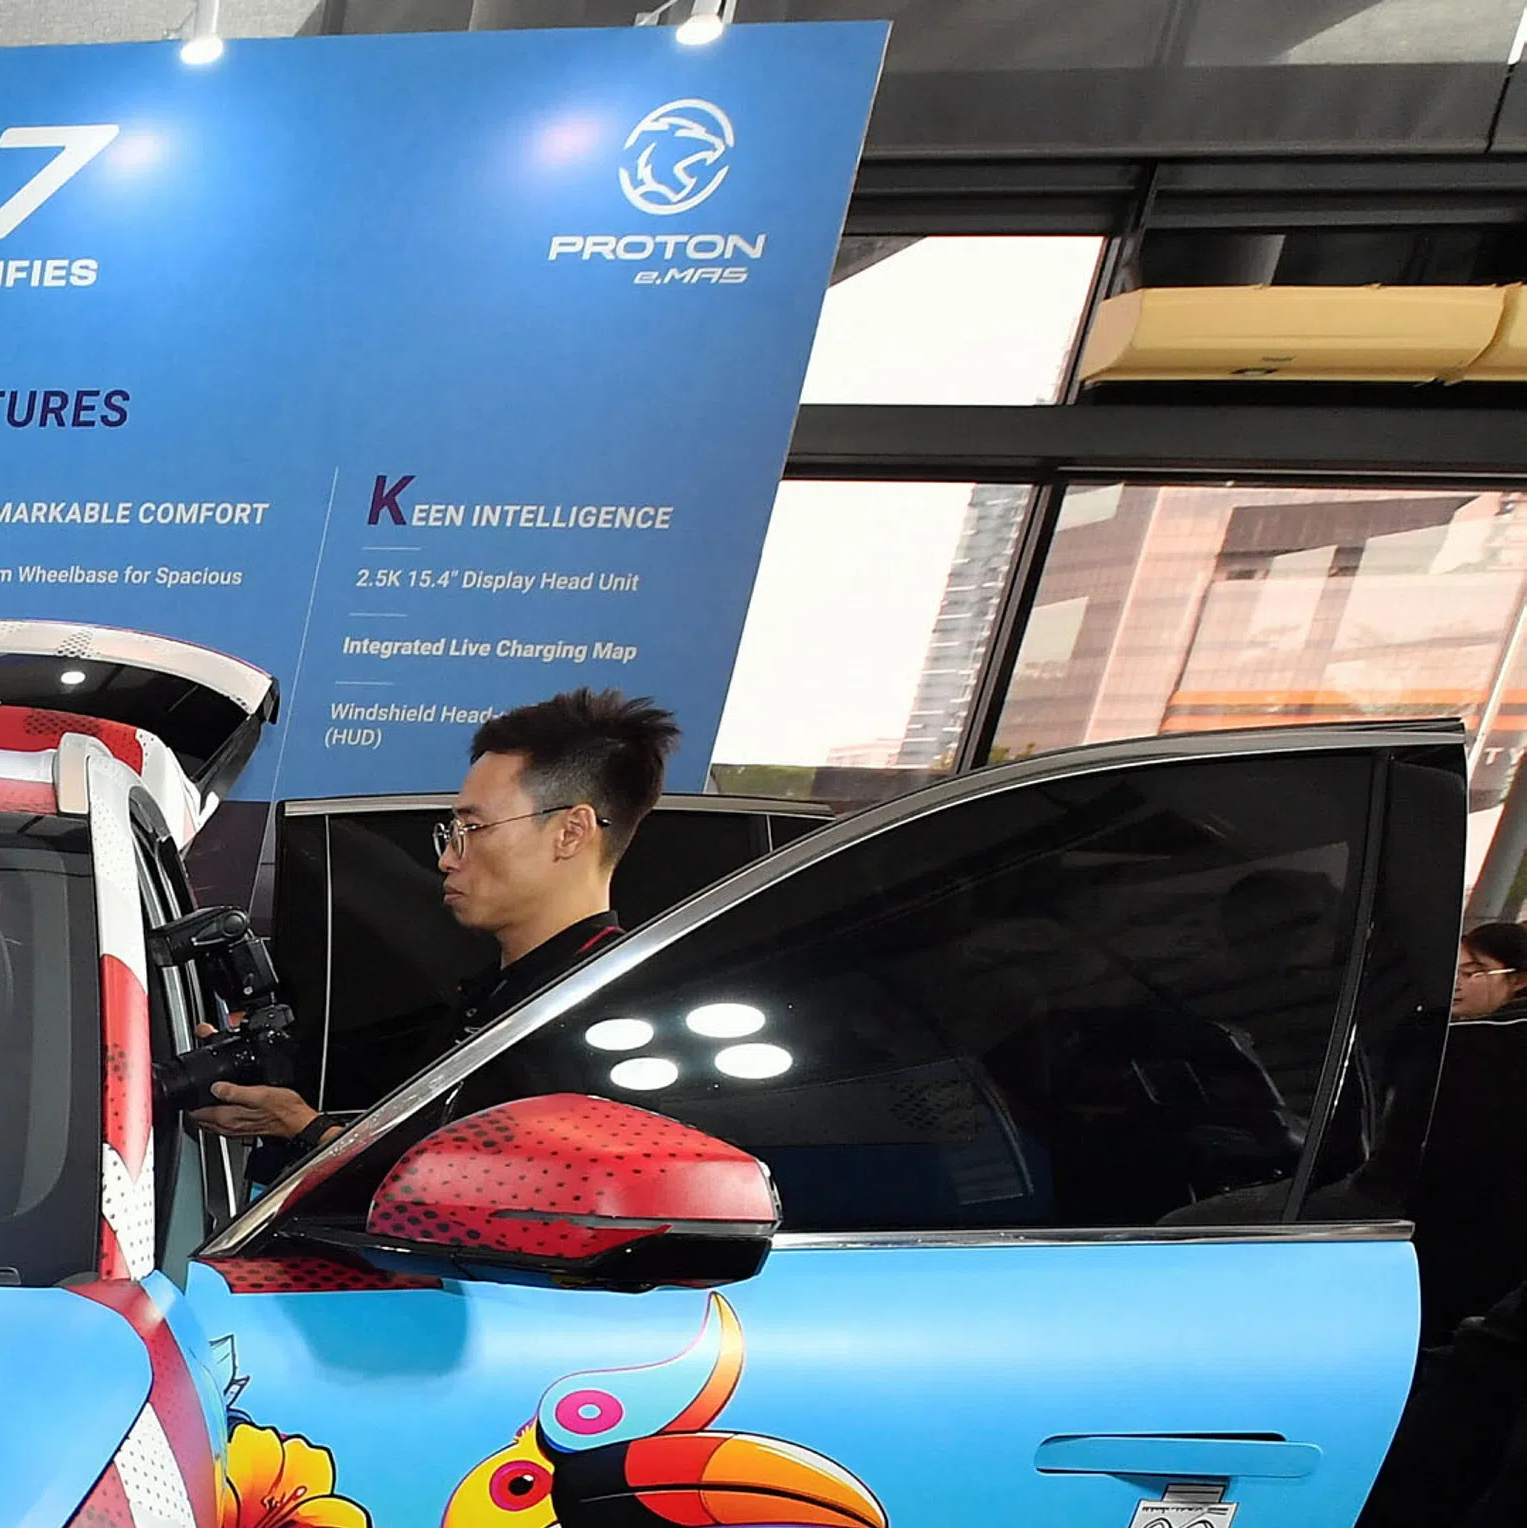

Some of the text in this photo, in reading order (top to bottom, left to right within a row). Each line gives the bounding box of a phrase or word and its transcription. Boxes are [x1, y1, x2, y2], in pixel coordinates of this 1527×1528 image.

[548, 233, 767, 260] PROTON
[138, 502, 269, 525] COMFORT
[367, 475, 674, 529] KEEN INTELLIGENCE
[18, 566, 119, 583] Wheelbase
[123, 566, 151, 584] for
[155, 567, 243, 588] Spacious
[356, 569, 402, 587] 2.5K
[461, 570, 535, 593] Display
[540, 572, 592, 590] Head
[598, 573, 639, 592] Unit
[343, 637, 637, 664] Integrated Live Charging Map
[330, 702, 436, 723] Windshield
[324, 727, 383, 749] (HUD)
